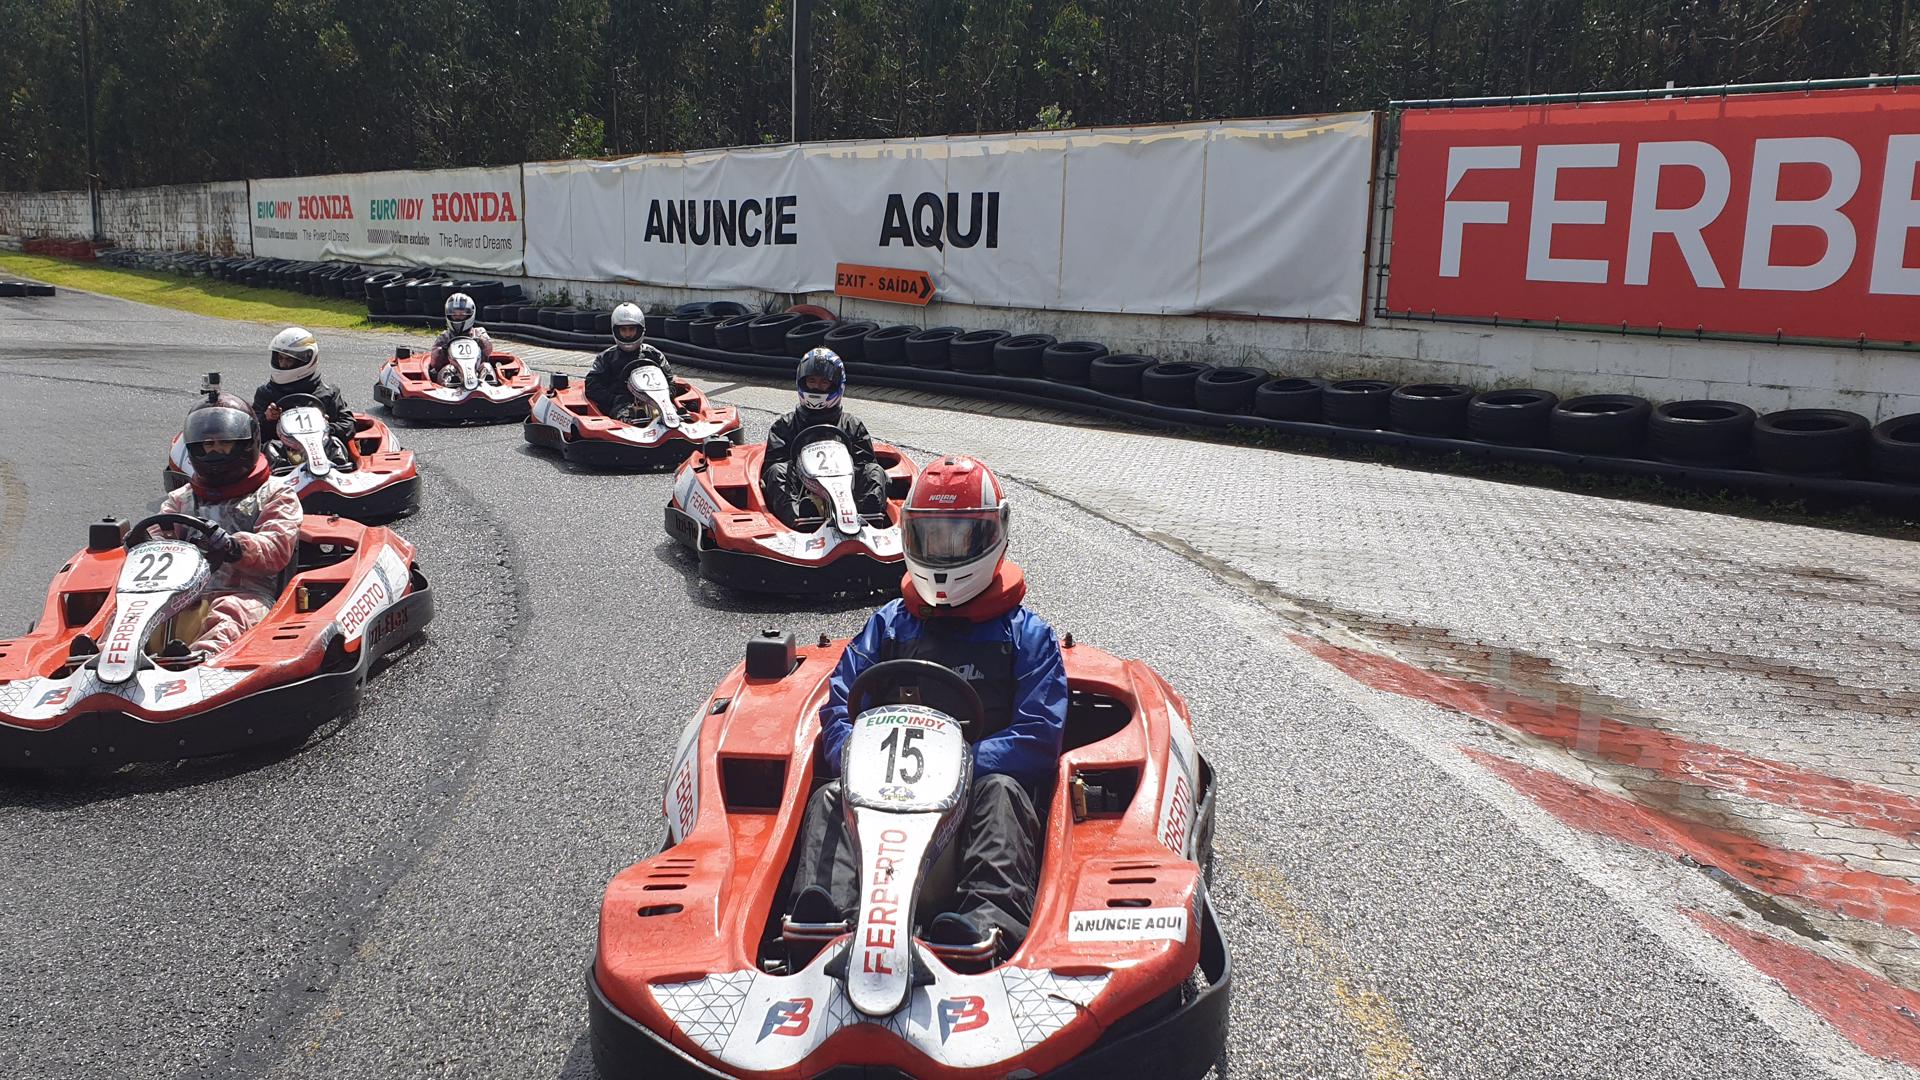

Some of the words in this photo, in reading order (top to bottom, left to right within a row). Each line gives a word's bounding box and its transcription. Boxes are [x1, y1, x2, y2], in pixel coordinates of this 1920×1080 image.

[297, 194, 354, 221] HONDA
[370, 198, 424, 221] EUROINDY
[431, 191, 517, 223] HONDA
[643, 195, 798, 247] ANUNCIE
[879, 191, 1000, 253] AQUI
[438, 232, 453, 248] The
[454, 233, 474, 249] Power
[482, 235, 513, 250] Dreams
[837, 272, 867, 289] EXIT
[878, 272, 919, 295] SAÍDA
[458, 344, 472, 355] 20
[295, 414, 313, 429] 11
[133, 552, 174, 582] 22
[107, 600, 149, 665] FERBERTO
[866, 715, 946, 730] EUROINDY
[880, 727, 925, 785] 15
[1164, 776, 1193, 856] RBERTO
[863, 829, 908, 976] FERBERTO
[1074, 917, 1143, 933] ANUNCIE
[1144, 916, 1183, 931] AQUI
